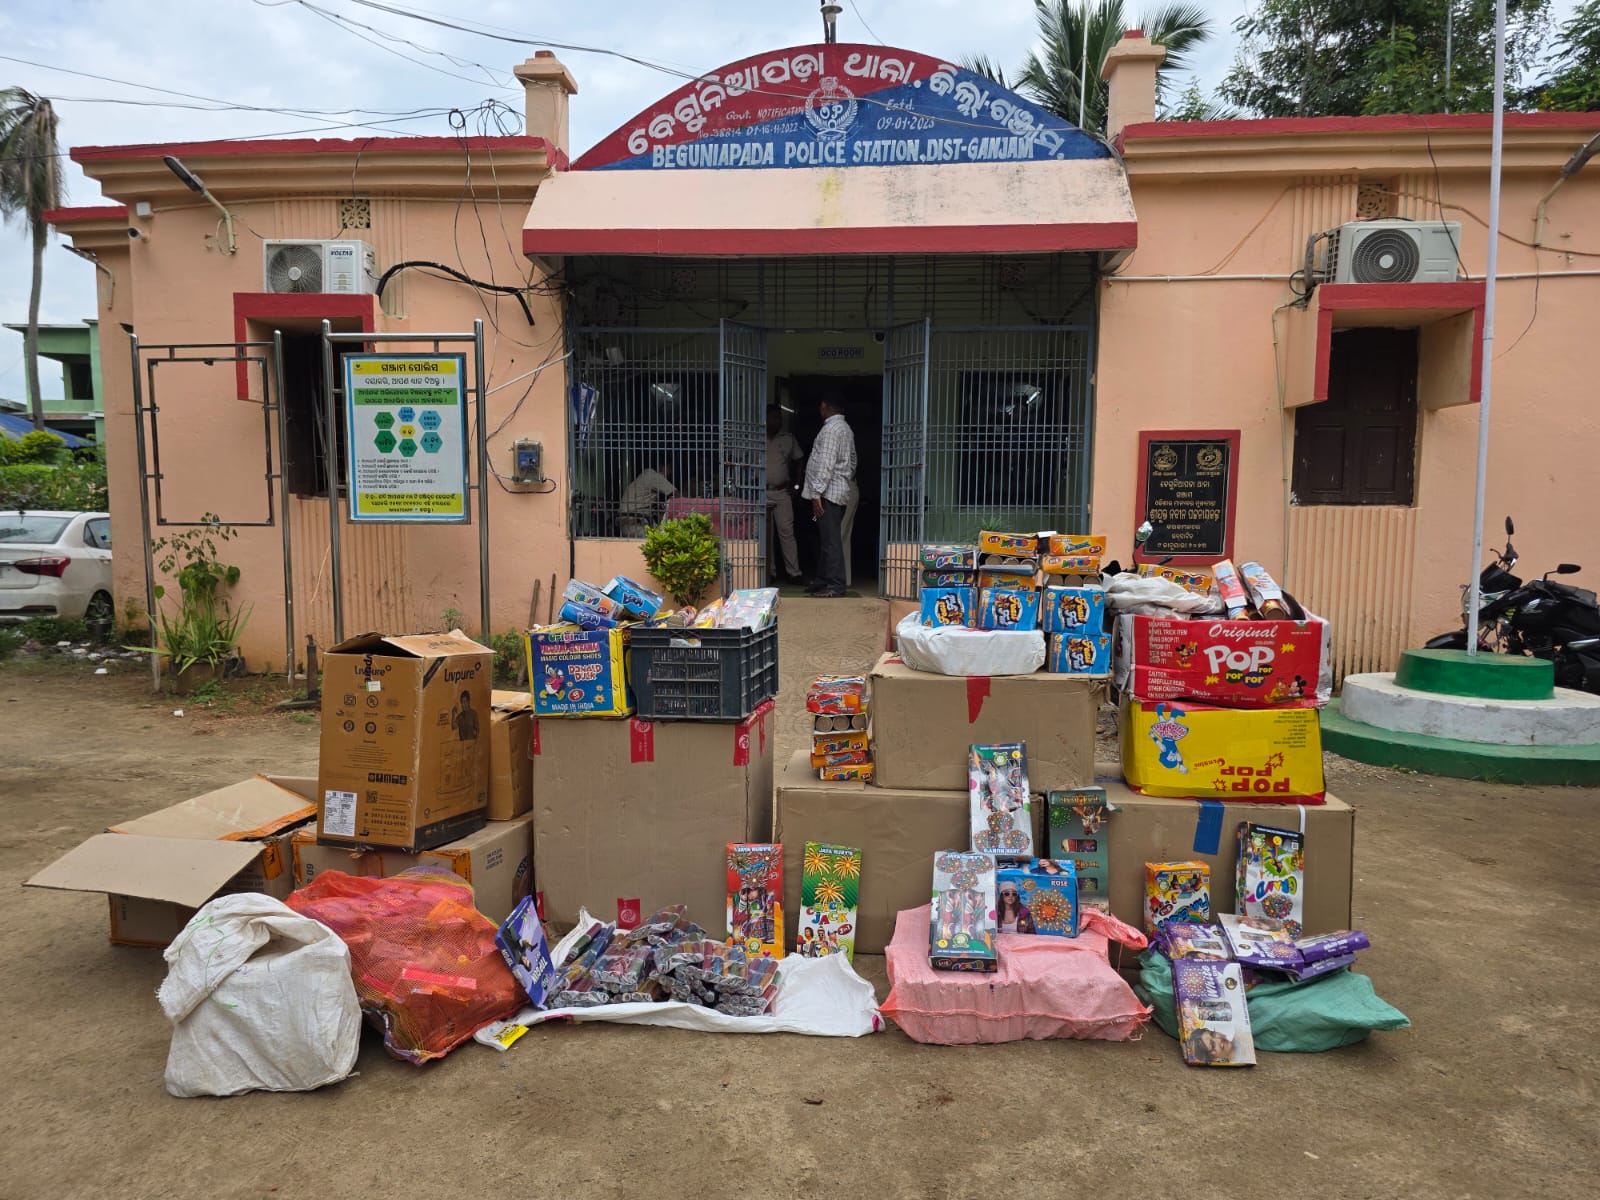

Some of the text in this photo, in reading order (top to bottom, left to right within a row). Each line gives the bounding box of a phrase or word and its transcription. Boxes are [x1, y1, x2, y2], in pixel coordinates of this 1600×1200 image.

[652, 141, 774, 168] BEGUNIAPADA
[784, 140, 847, 165] POLICE
[1208, 623, 1279, 643] Original
[1203, 645, 1275, 674] POP
[354, 665, 385, 677] Liure
[444, 666, 475, 684] Livpure
[1245, 676, 1264, 684] POP
[1221, 766, 1273, 777] POP
[1231, 777, 1290, 793] POP
[811, 911, 849, 925] JACK
